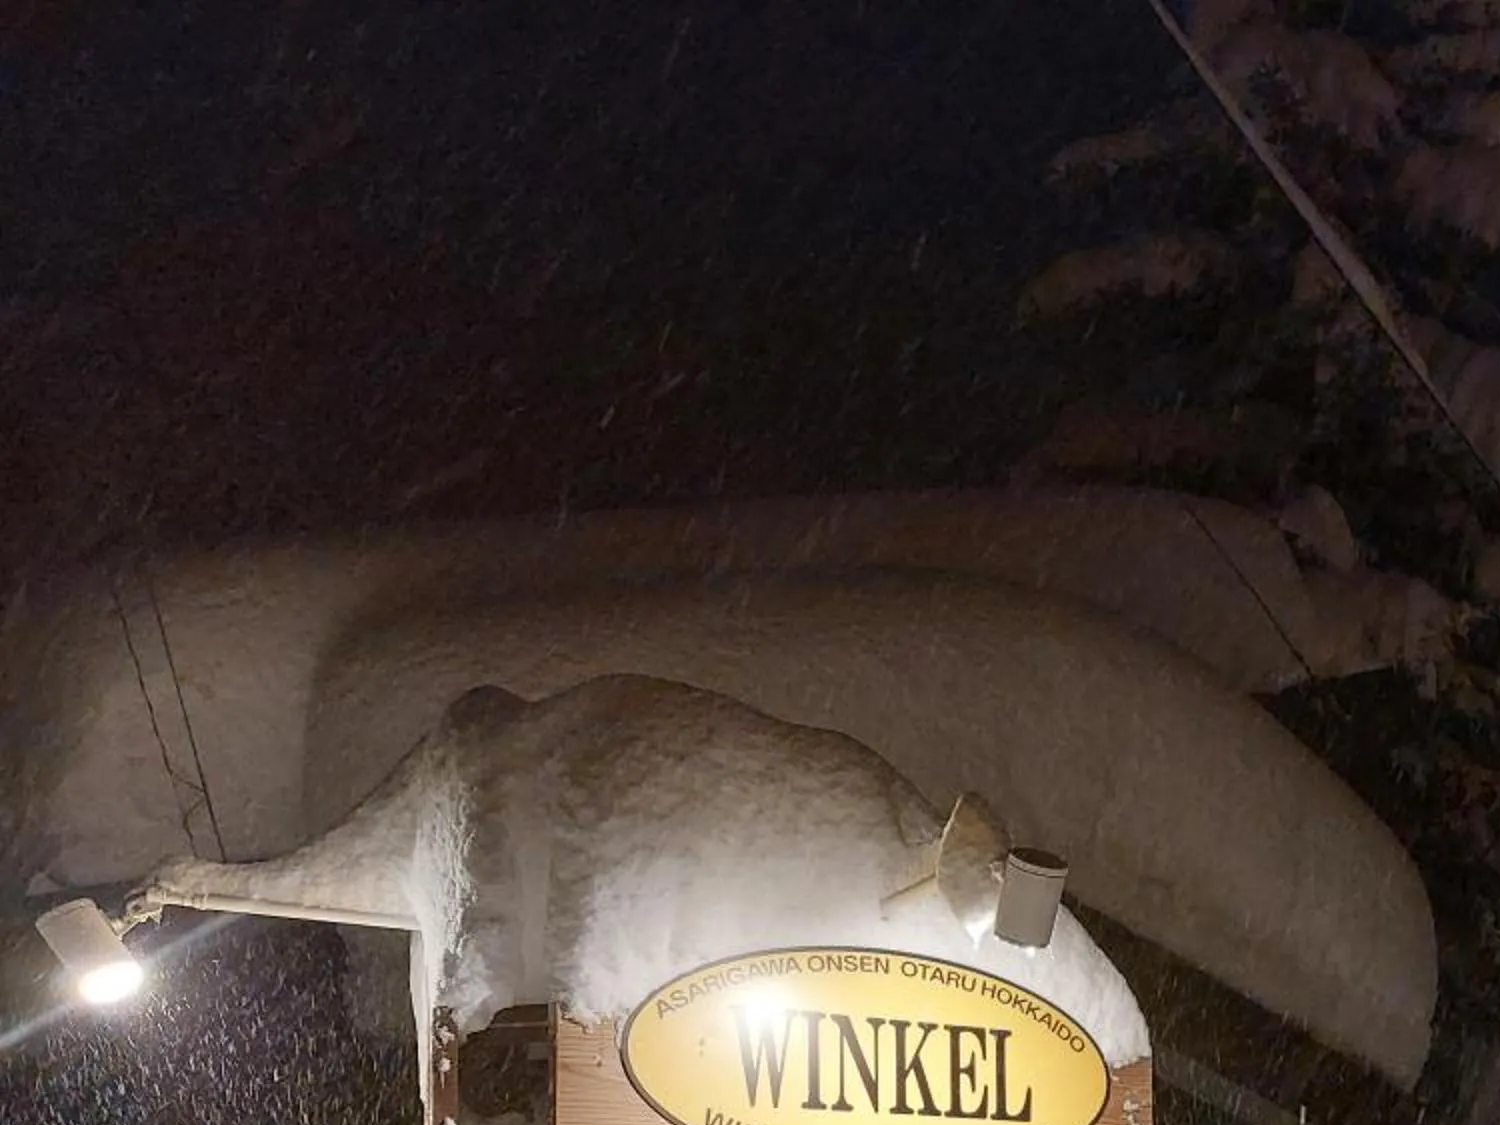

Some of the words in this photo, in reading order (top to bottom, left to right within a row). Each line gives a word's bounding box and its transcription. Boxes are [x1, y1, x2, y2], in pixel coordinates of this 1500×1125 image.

[656, 956, 802, 1019] ASARIGAWA
[807, 954, 890, 974] ONSEN
[901, 961, 977, 992] OTARU
[981, 979, 1086, 1053] HOKKAIDO
[730, 1005, 1032, 1123] WINKEL
